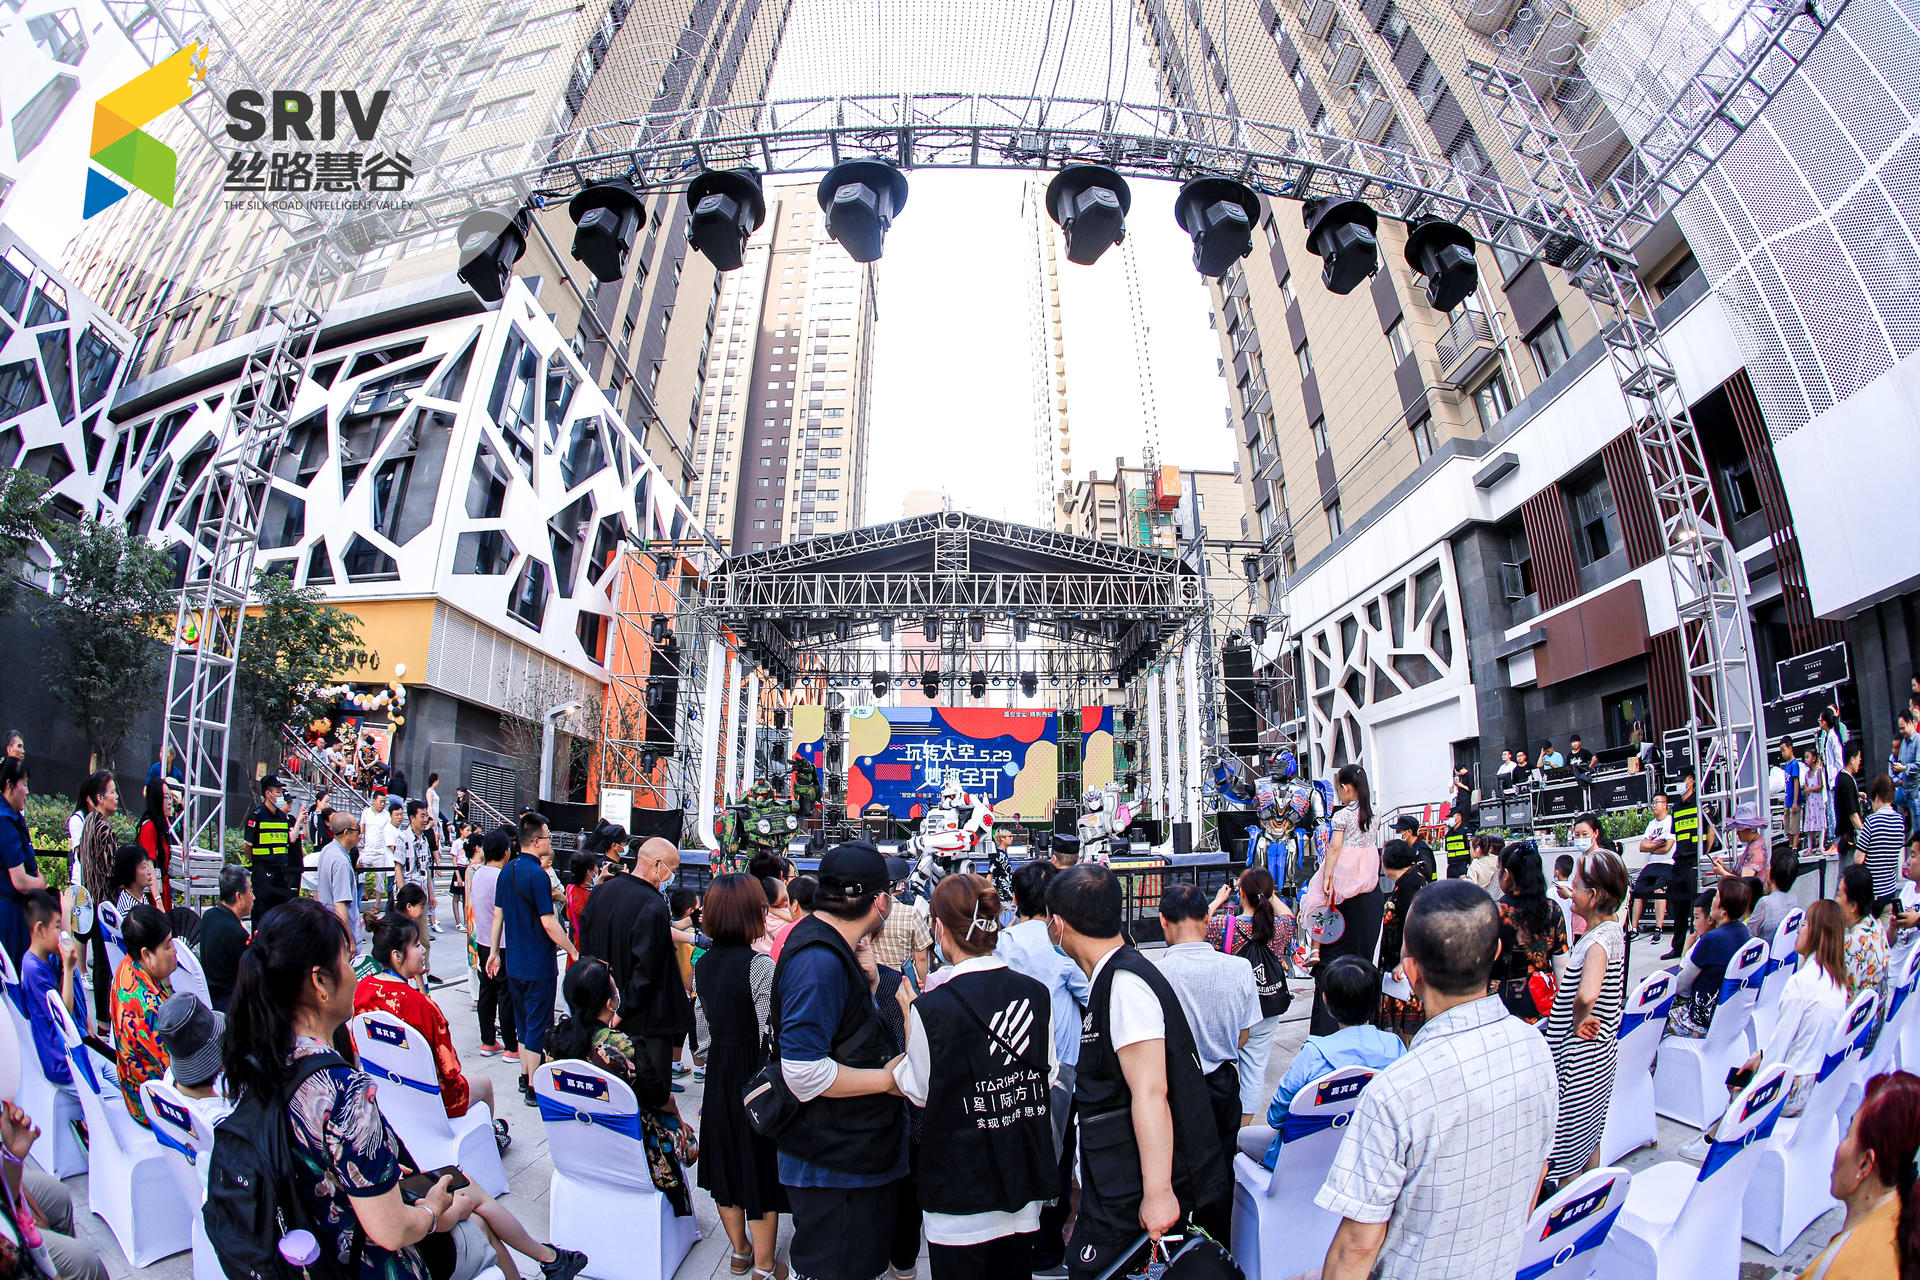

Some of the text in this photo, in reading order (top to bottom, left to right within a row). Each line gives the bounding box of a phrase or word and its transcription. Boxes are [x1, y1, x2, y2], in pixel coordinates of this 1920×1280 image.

[897, 739, 1012, 766] 玩转太空 5.29
[566, 1078, 594, 1091] 嘉宾席
